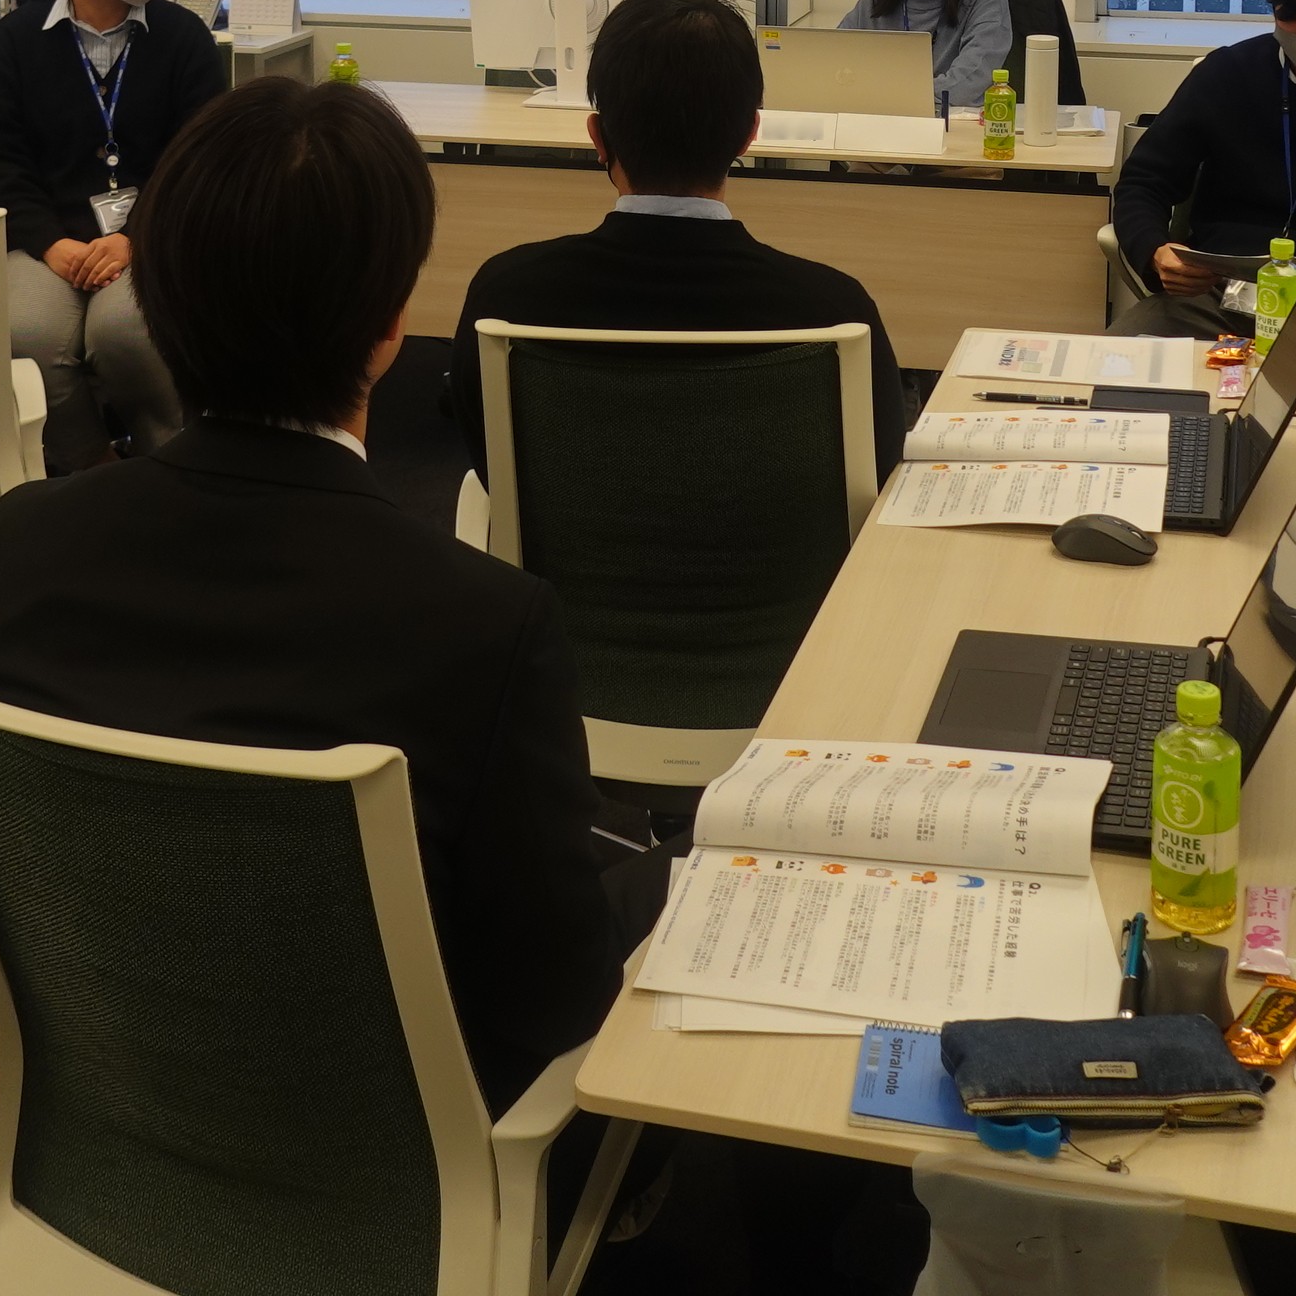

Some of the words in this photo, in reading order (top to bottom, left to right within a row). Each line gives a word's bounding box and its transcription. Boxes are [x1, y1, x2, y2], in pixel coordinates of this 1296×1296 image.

[1161, 828, 1201, 851] PURE
[1158, 841, 1206, 866] GREEN
[889, 1037, 907, 1069] spiral
[885, 1071, 900, 1096] note
